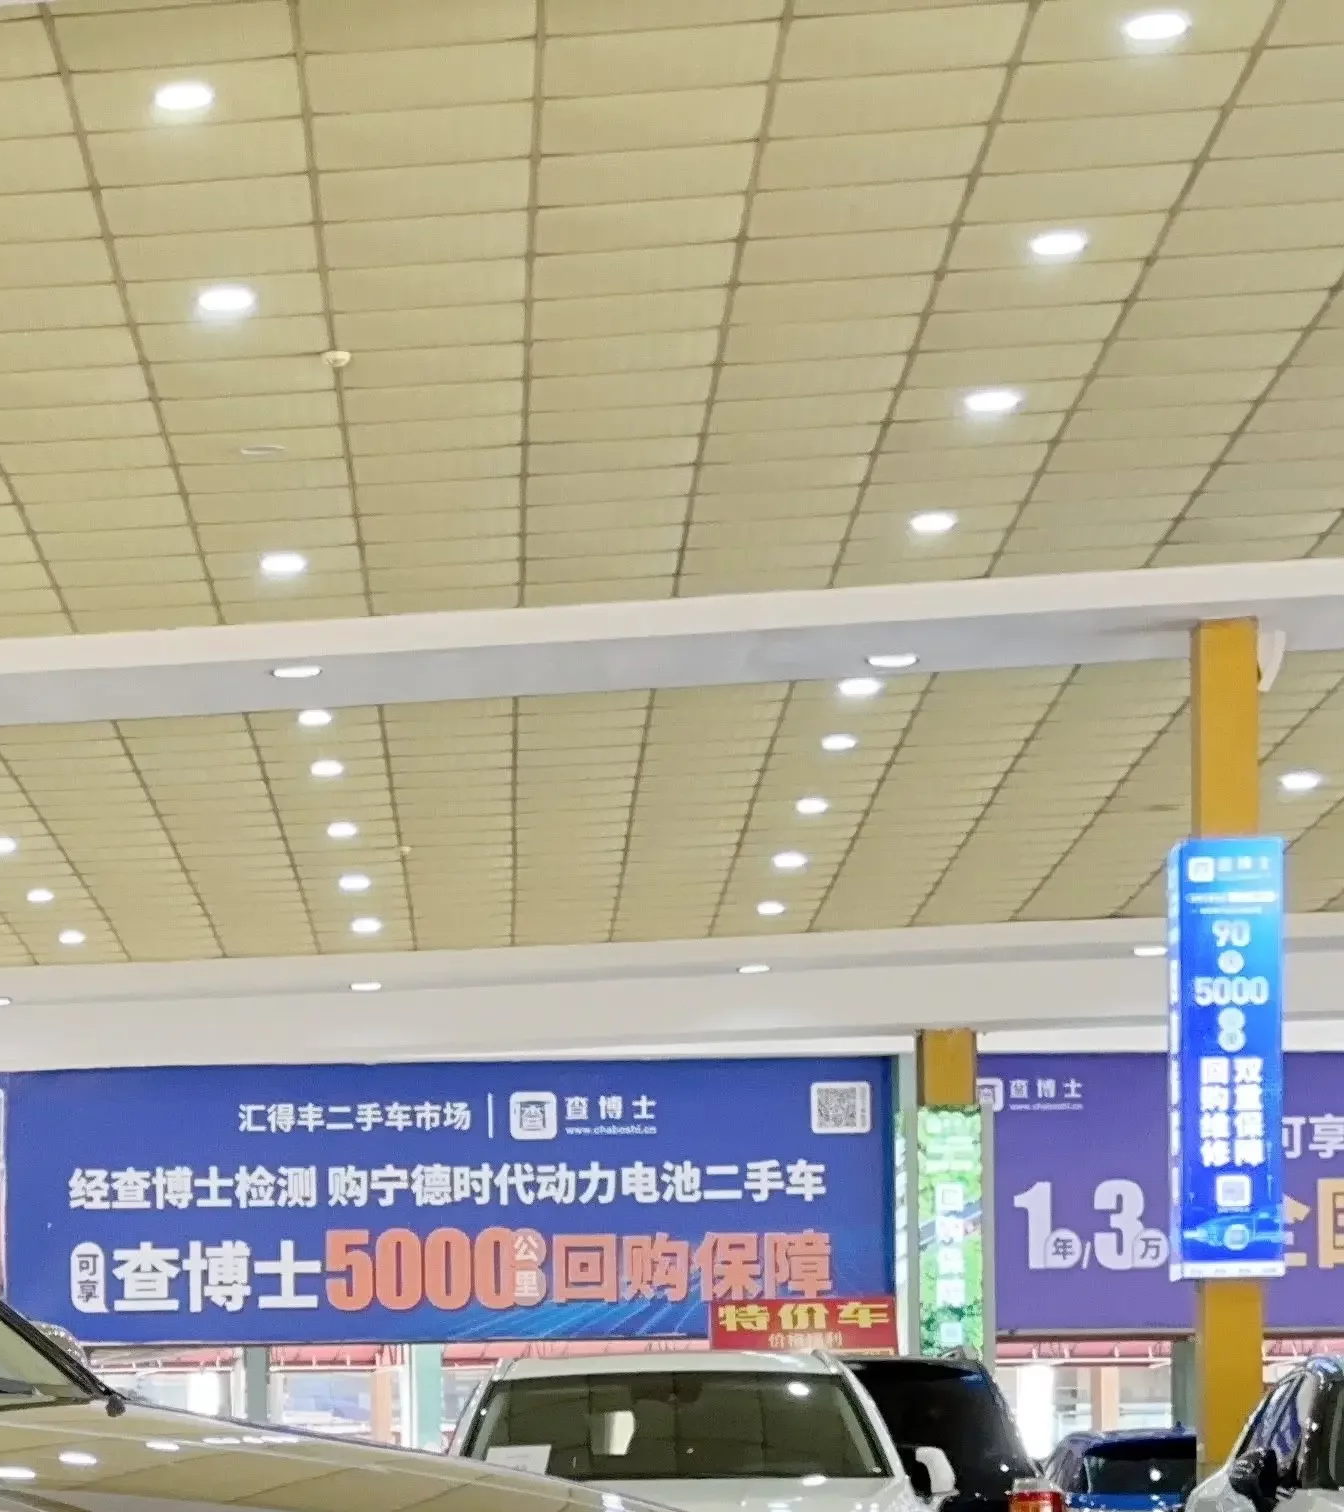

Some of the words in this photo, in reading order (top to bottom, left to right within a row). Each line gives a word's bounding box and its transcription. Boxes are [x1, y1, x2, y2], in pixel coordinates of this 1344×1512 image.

[1194, 975, 1270, 1006] 5000
[238, 1103, 471, 1134] 汇得丰二手车市场
[564, 1095, 657, 1121] 查博士
[68, 1164, 317, 1210] 经查博士检测
[328, 1159, 826, 1206] 购宁德时代动力电池二手车
[76, 1253, 100, 1303] 可享
[112, 1239, 322, 1313] 查博士
[325, 1226, 515, 1311] 5000
[552, 1227, 832, 1301] 回购保障
[718, 1301, 890, 1332] 特价车
